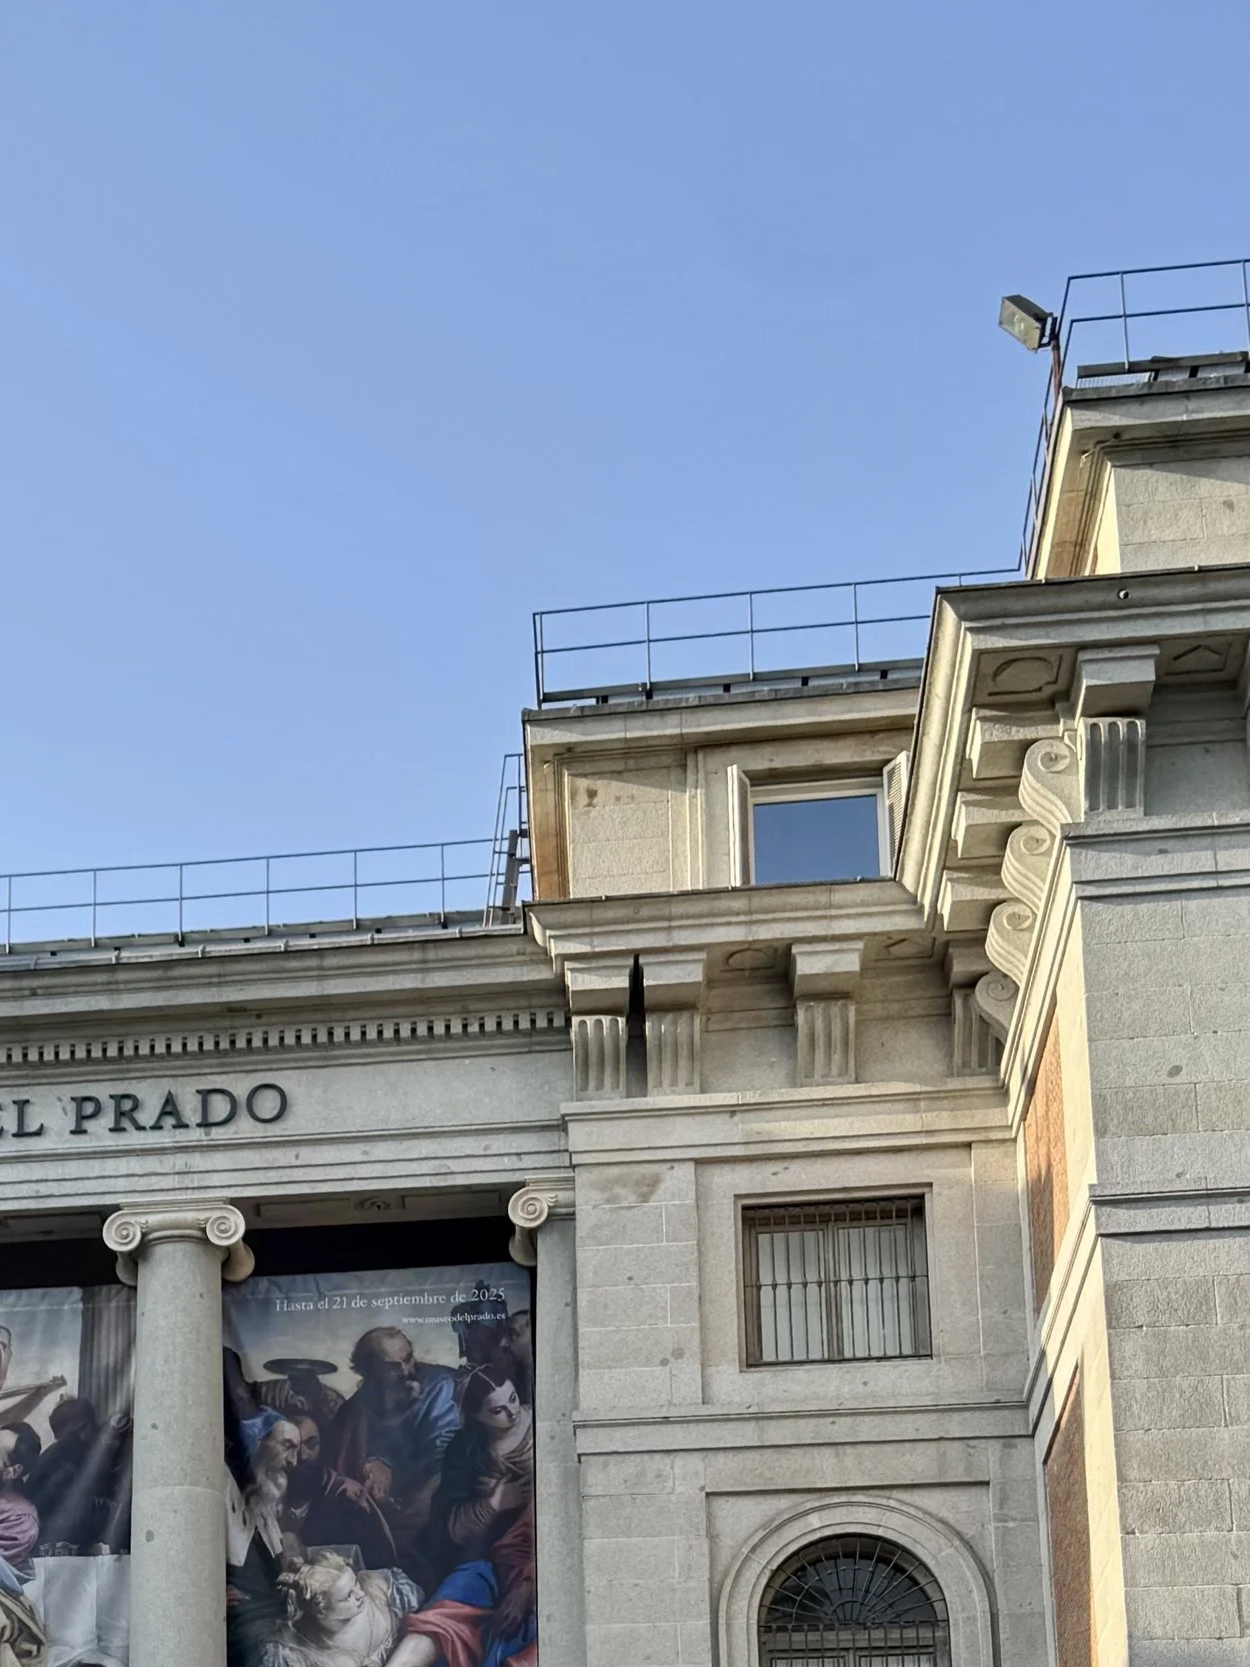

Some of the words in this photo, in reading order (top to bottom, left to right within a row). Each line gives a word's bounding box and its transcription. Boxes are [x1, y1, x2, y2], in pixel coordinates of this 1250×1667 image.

[69, 1083, 289, 1136] PRADO
[275, 1298, 314, 1312] Hasta
[317, 1297, 329, 1310] el
[332, 1297, 348, 1310] 21
[351, 1295, 368, 1308] de
[371, 1291, 446, 1310] septiembre
[450, 1290, 467, 1303] de
[471, 1288, 506, 1302] 2025
